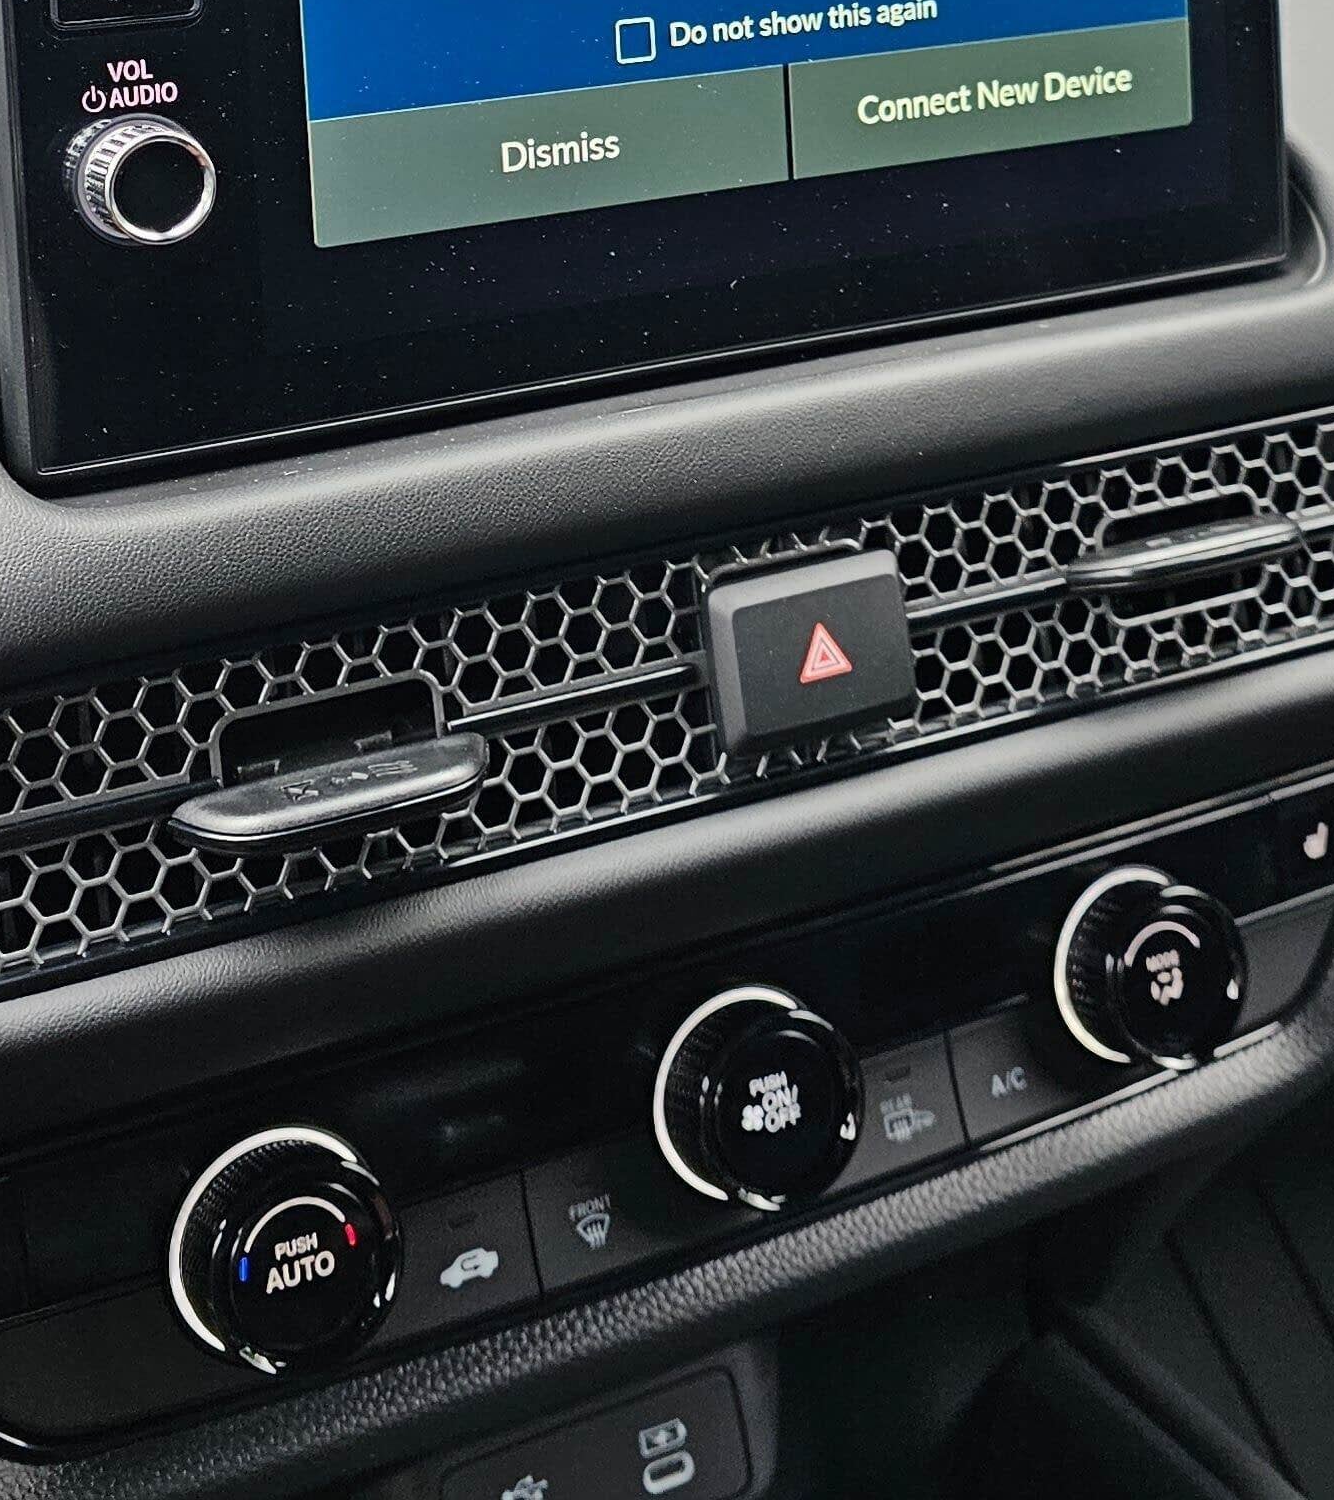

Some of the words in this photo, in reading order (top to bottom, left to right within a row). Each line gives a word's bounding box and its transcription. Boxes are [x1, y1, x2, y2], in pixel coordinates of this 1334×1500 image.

[670, 22, 707, 48] Do
[713, 18, 755, 44] not
[759, 6, 822, 38] show
[828, 3, 871, 29] this
[107, 60, 152, 82] VOL
[109, 82, 178, 108] AUDIO
[857, 86, 970, 125] Connect
[977, 78, 1038, 108] New
[1045, 67, 1132, 99] Device
[502, 133, 620, 173] Dismiss
[991, 1067, 1027, 1098] A/C
[569, 1194, 611, 1221] FRONT
[275, 1232, 318, 1261] PUSH
[266, 1250, 335, 1294] AUTO
